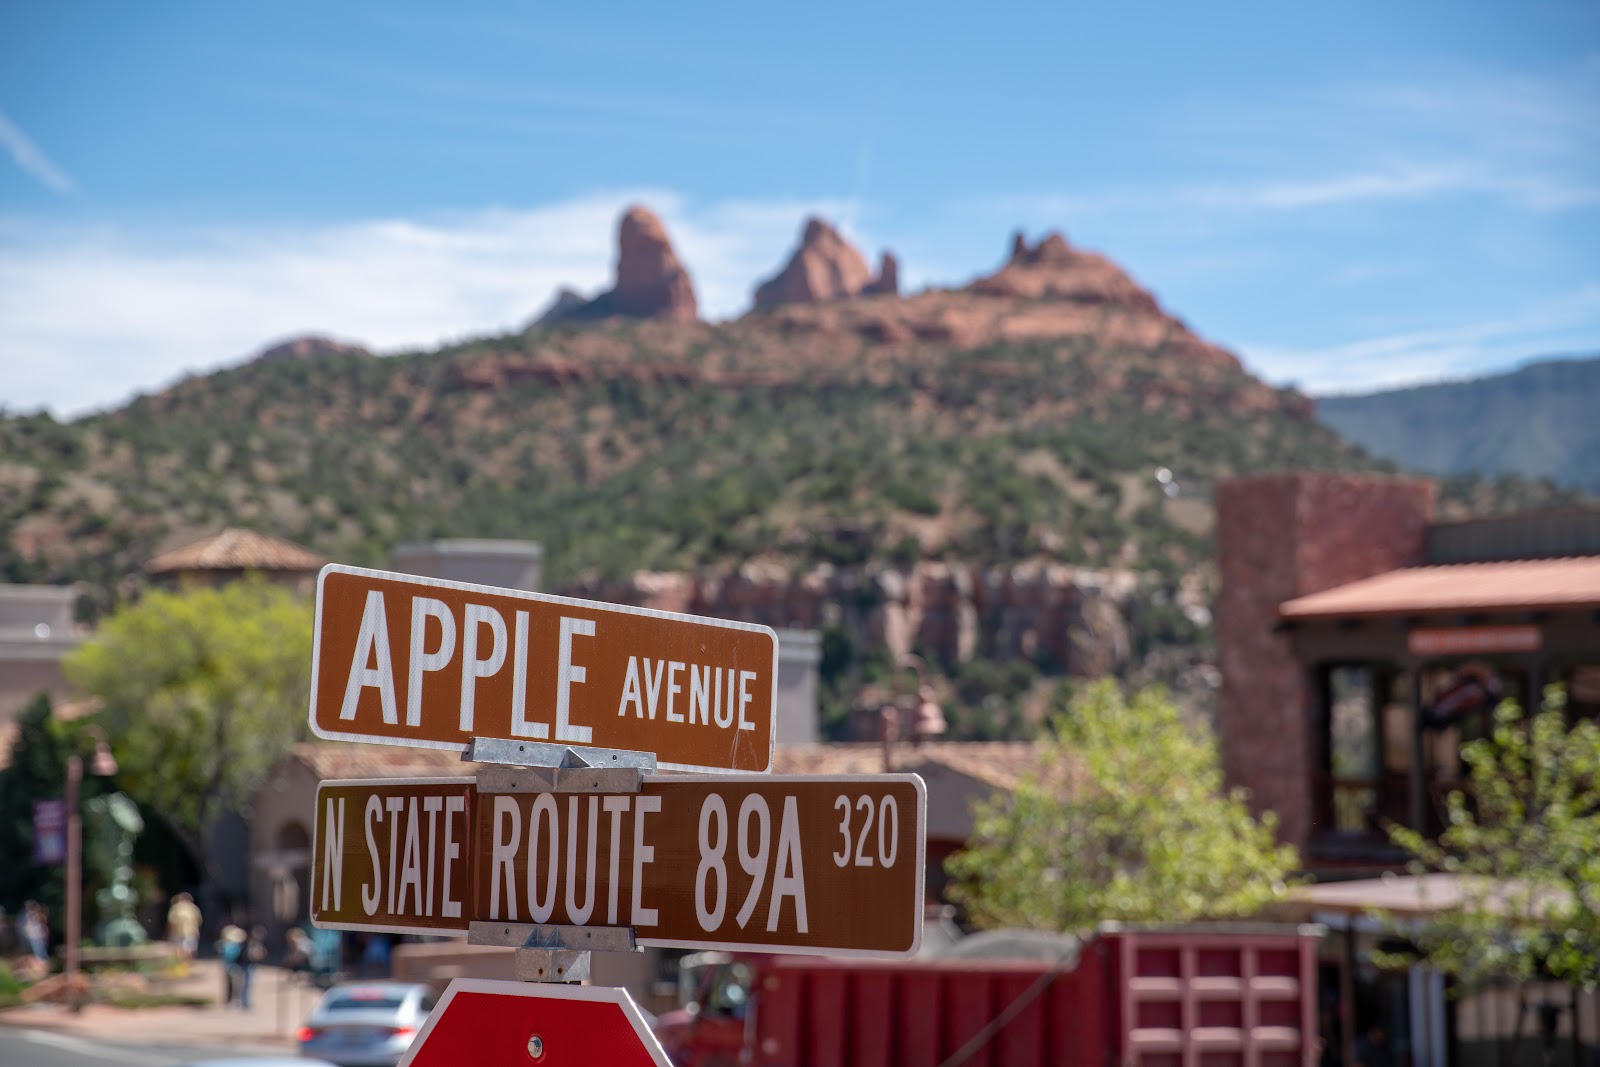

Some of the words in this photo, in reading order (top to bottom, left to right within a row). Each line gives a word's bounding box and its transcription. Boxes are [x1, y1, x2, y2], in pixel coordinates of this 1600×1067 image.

[339, 590, 597, 744] APPLE
[618, 655, 758, 731] AVENUE
[321, 797, 345, 912] N
[361, 793, 467, 919] STATE
[489, 792, 663, 927] ROUTE
[695, 792, 809, 934] 89A
[833, 794, 899, 869] 320
